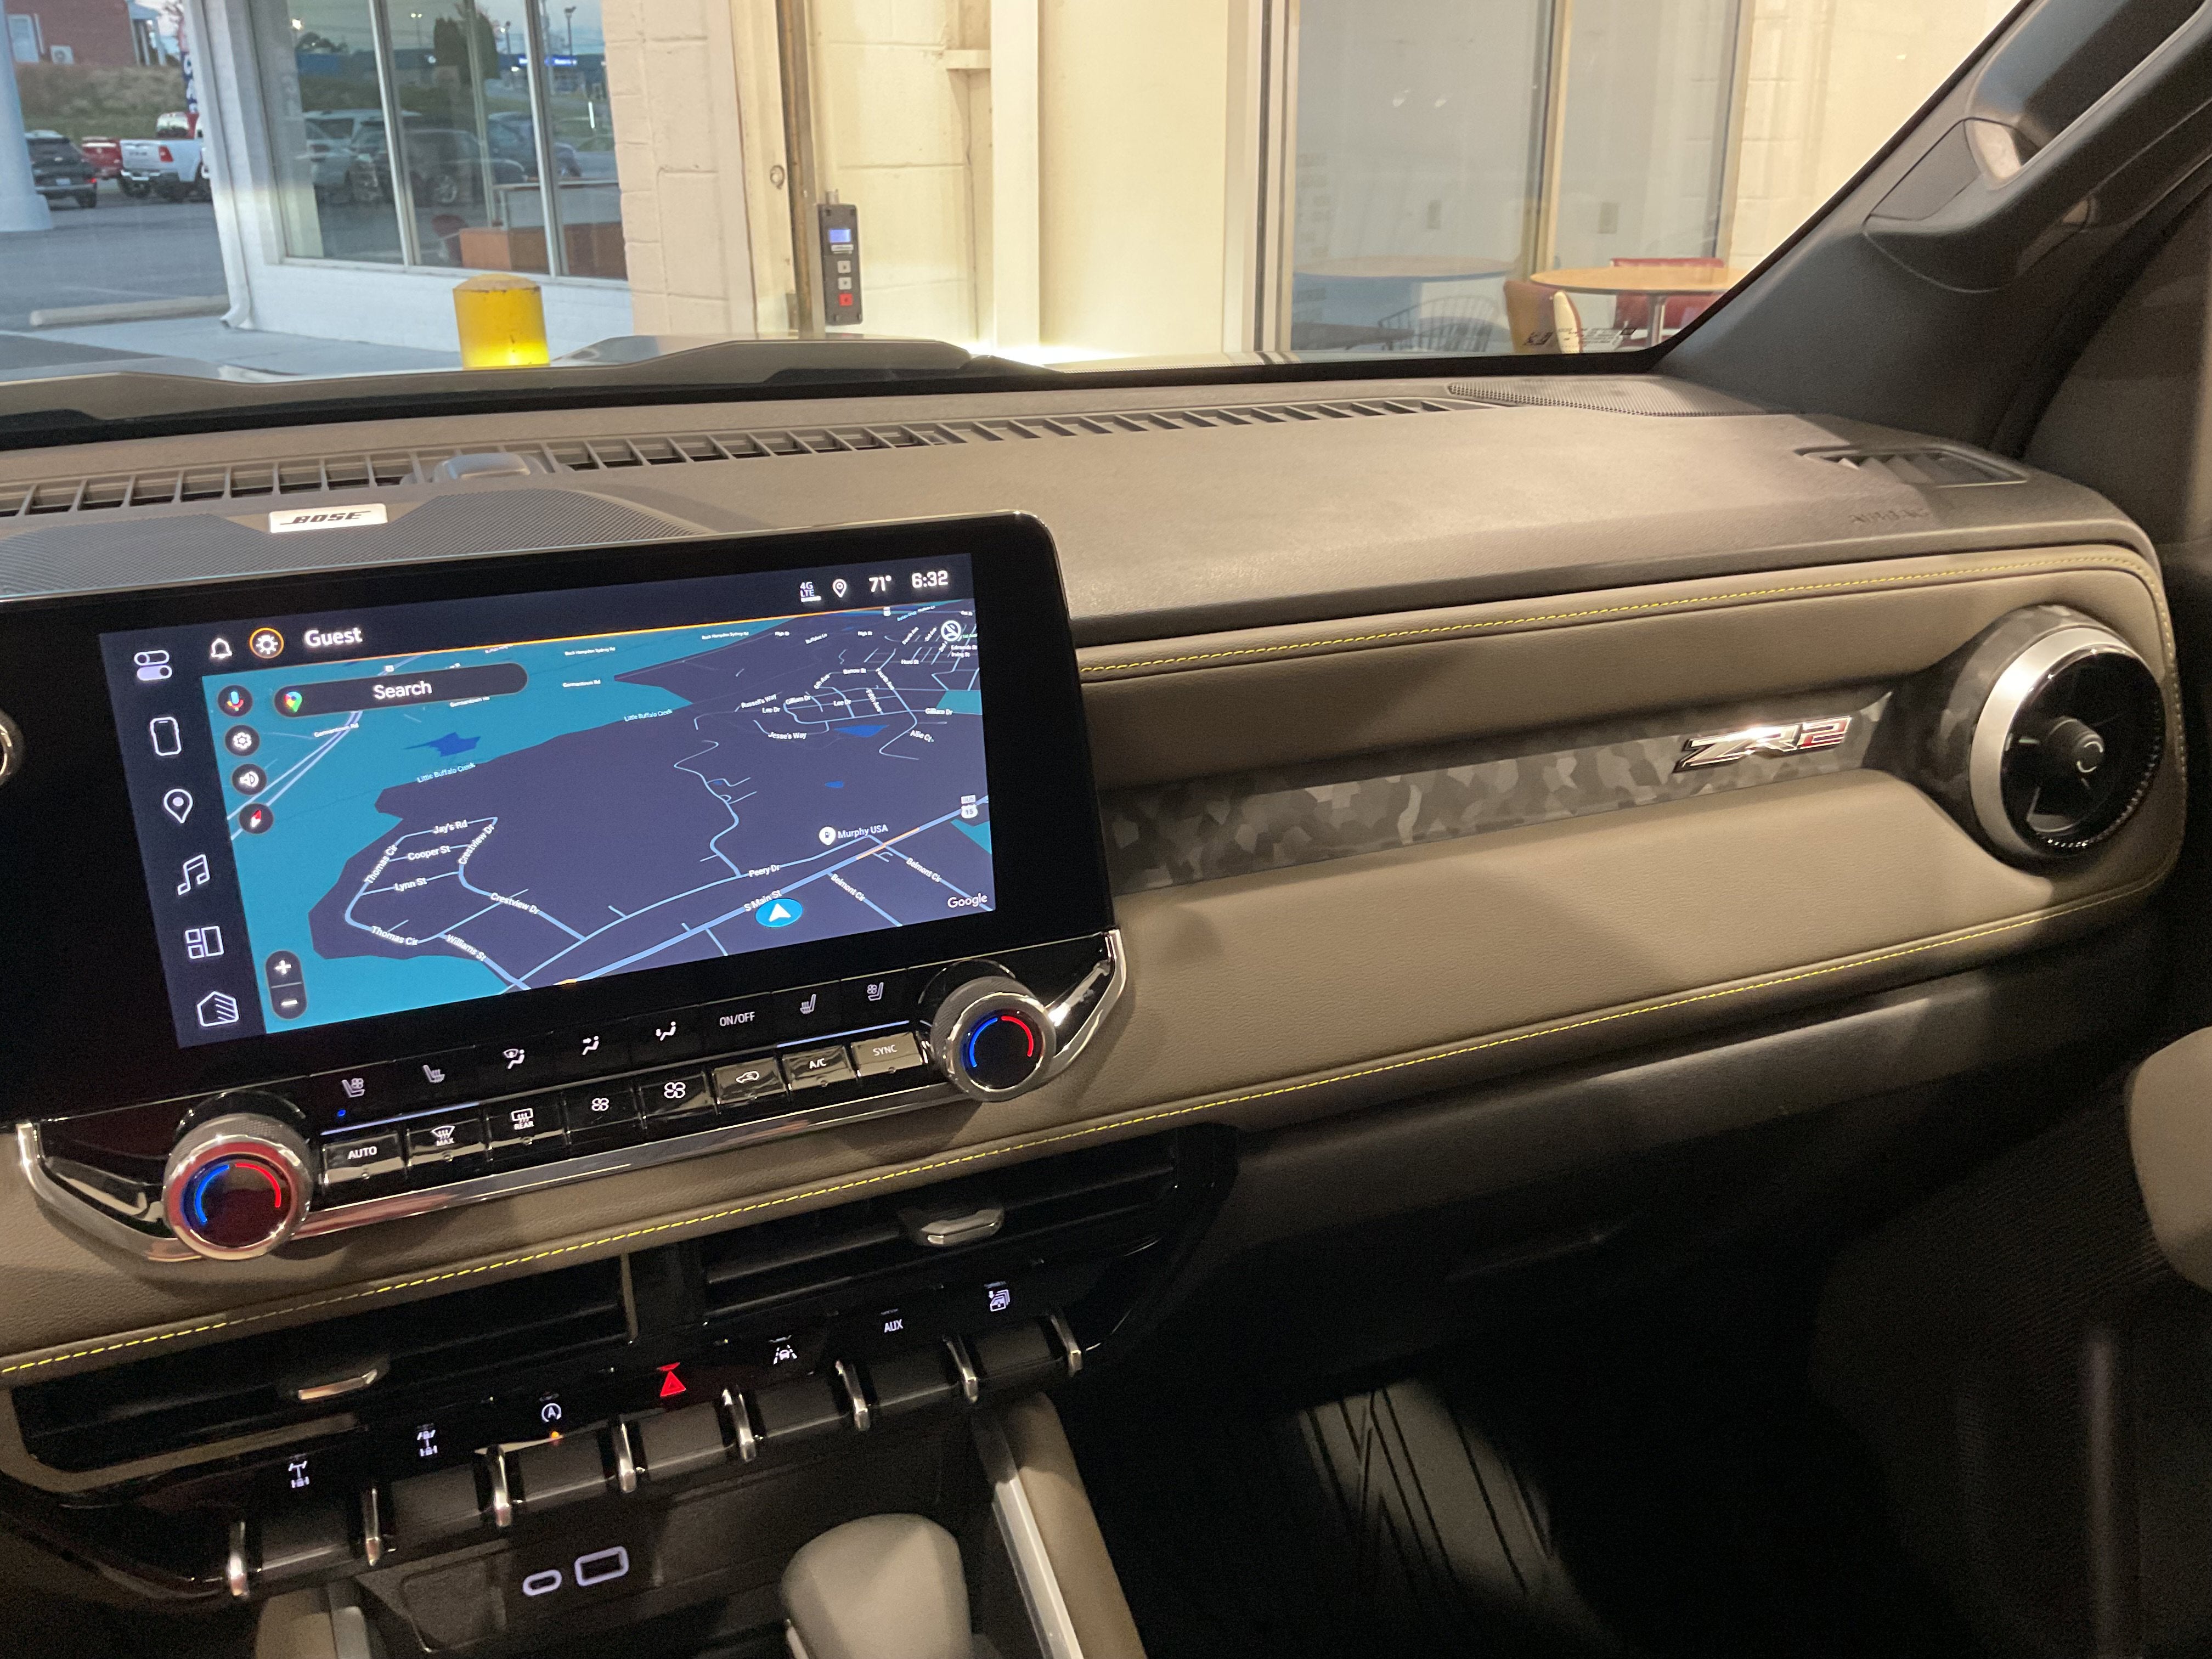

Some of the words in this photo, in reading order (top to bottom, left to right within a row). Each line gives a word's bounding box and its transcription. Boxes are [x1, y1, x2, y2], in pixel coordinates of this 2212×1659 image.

[280, 511, 371, 525] BOSE
[800, 582, 813, 590] 4G
[869, 575, 891, 593] 71°
[912, 571, 948, 588] 6:32
[800, 589, 814, 597] LTE
[304, 628, 363, 647] Guest
[374, 681, 432, 700] Search
[764, 694, 777, 702] Way
[314, 726, 350, 737] Germantown
[768, 731, 792, 740] Jesse's
[910, 730, 924, 739] Allie
[417, 773, 433, 783] Little
[433, 768, 457, 778] Buffalo
[457, 762, 476, 772] Creek
[432, 822, 454, 834] Jay's
[455, 820, 468, 828] Rd
[838, 827, 870, 840] Murphy
[870, 824, 888, 833] USA
[458, 832, 487, 865] Crestview
[483, 823, 495, 836] Dr
[407, 848, 439, 861] Cooper
[439, 845, 451, 854] St
[364, 855, 391, 884] Thomas
[385, 843, 399, 857] Cir
[749, 867, 770, 878] Peery
[771, 864, 780, 872] Dr
[906, 857, 934, 879] Belmont
[932, 873, 941, 883] Cir
[394, 879, 416, 892] Lynn
[416, 877, 428, 887] St
[831, 873, 857, 896] Belmont
[490, 892, 530, 910] Crestview
[528, 904, 540, 915] Dr
[744, 902, 751, 912] S
[751, 895, 772, 909] Main
[771, 889, 782, 899] St
[947, 893, 988, 909] Google
[371, 926, 405, 944] Thomas
[405, 936, 419, 946] Cir
[445, 934, 478, 956] Williams
[475, 950, 487, 962] St
[719, 1012, 755, 1026] ON/OFF
[873, 1045, 898, 1057] SYNC
[809, 1058, 827, 1069] A/C
[514, 1121, 535, 1130] REAR
[436, 1138, 454, 1147] MAX
[347, 1146, 377, 1160] AUTO
[884, 1319, 904, 1333] AUX
